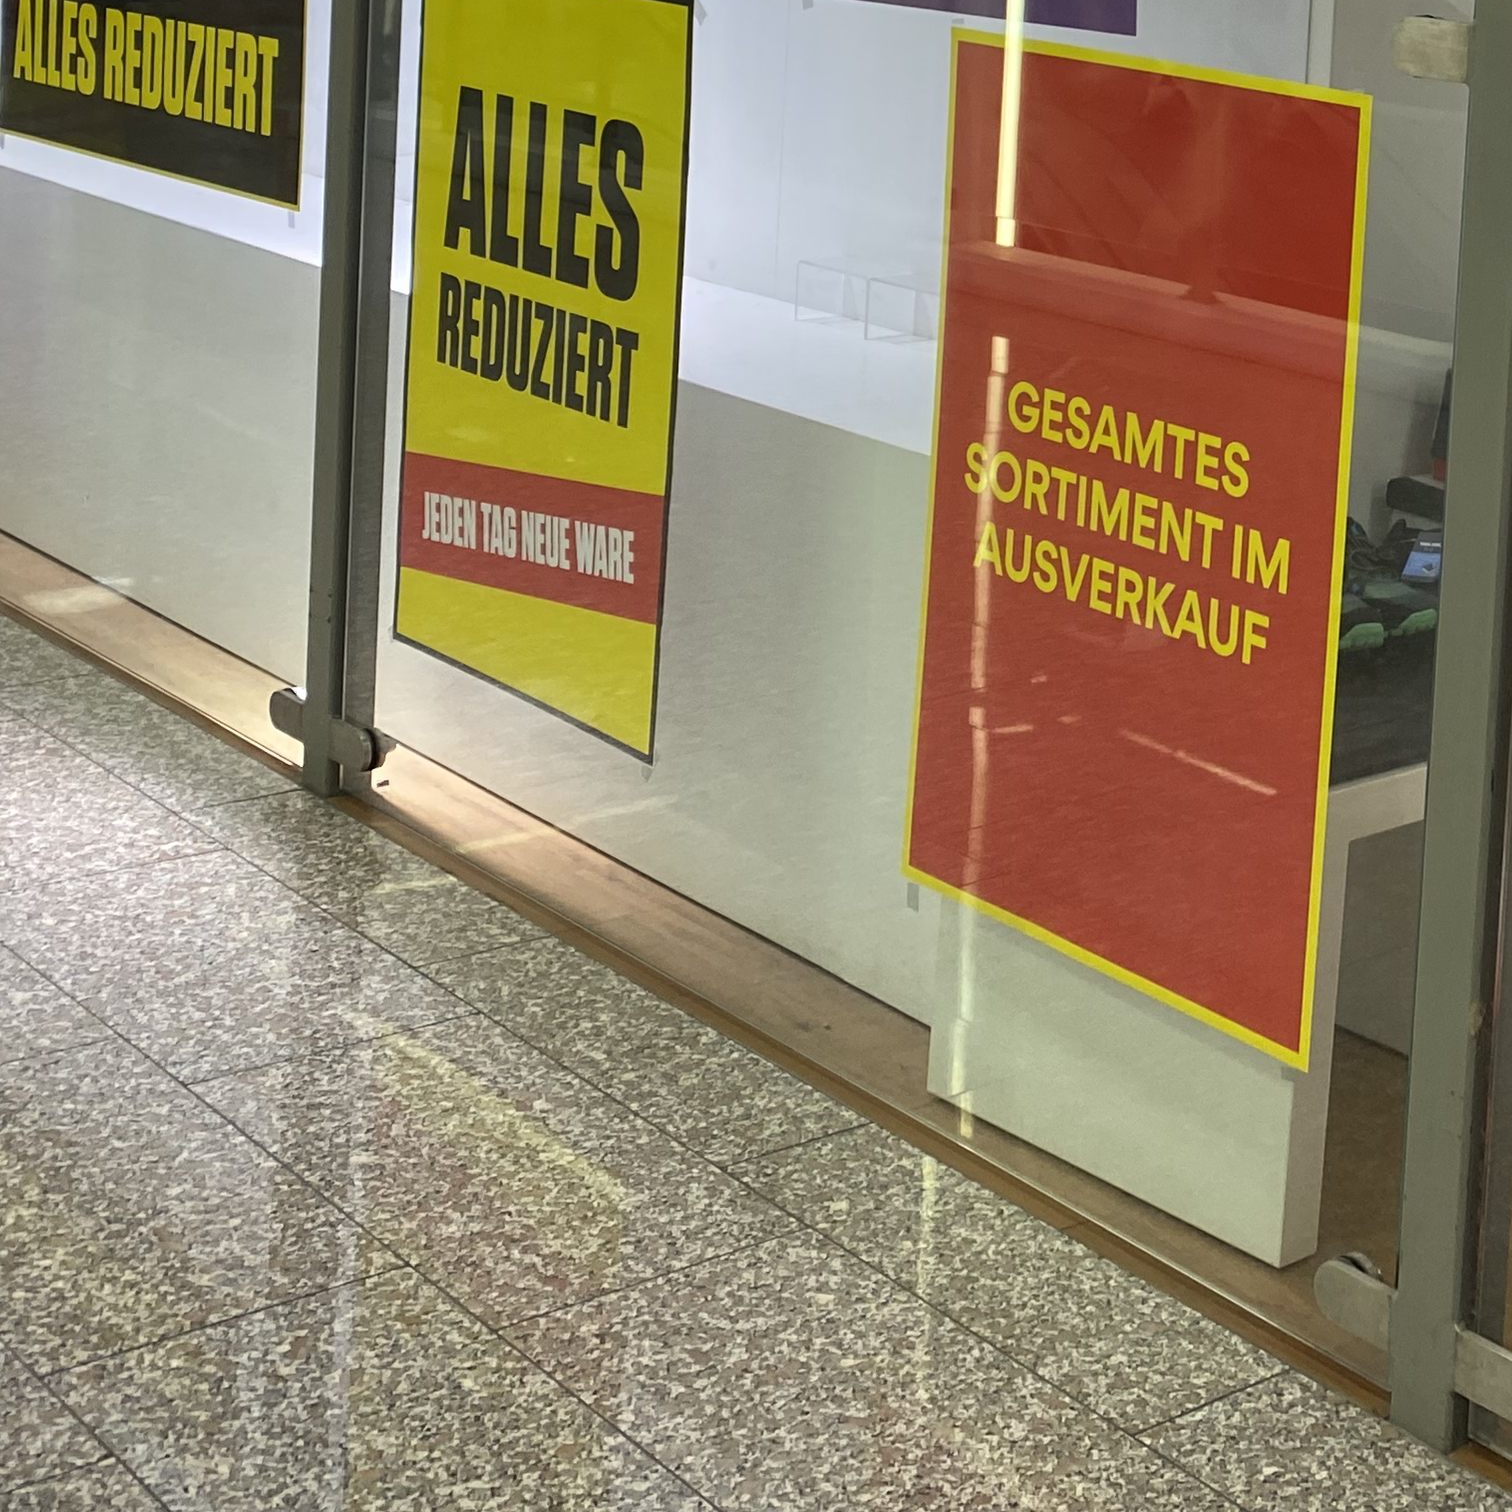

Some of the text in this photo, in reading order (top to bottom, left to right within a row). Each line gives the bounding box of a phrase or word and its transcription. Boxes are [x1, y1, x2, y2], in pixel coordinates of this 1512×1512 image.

[104, 7, 279, 136] REDUZIERT
[443, 85, 645, 302] ALLES
[436, 272, 639, 429] REDUZIERT
[1007, 380, 1250, 498] GESAMTES
[422, 491, 635, 584] JEDEN TAG NEUE WARE
[964, 441, 1291, 595] SORTIMENT IM
[973, 521, 1270, 665] AUSVERKAUF
